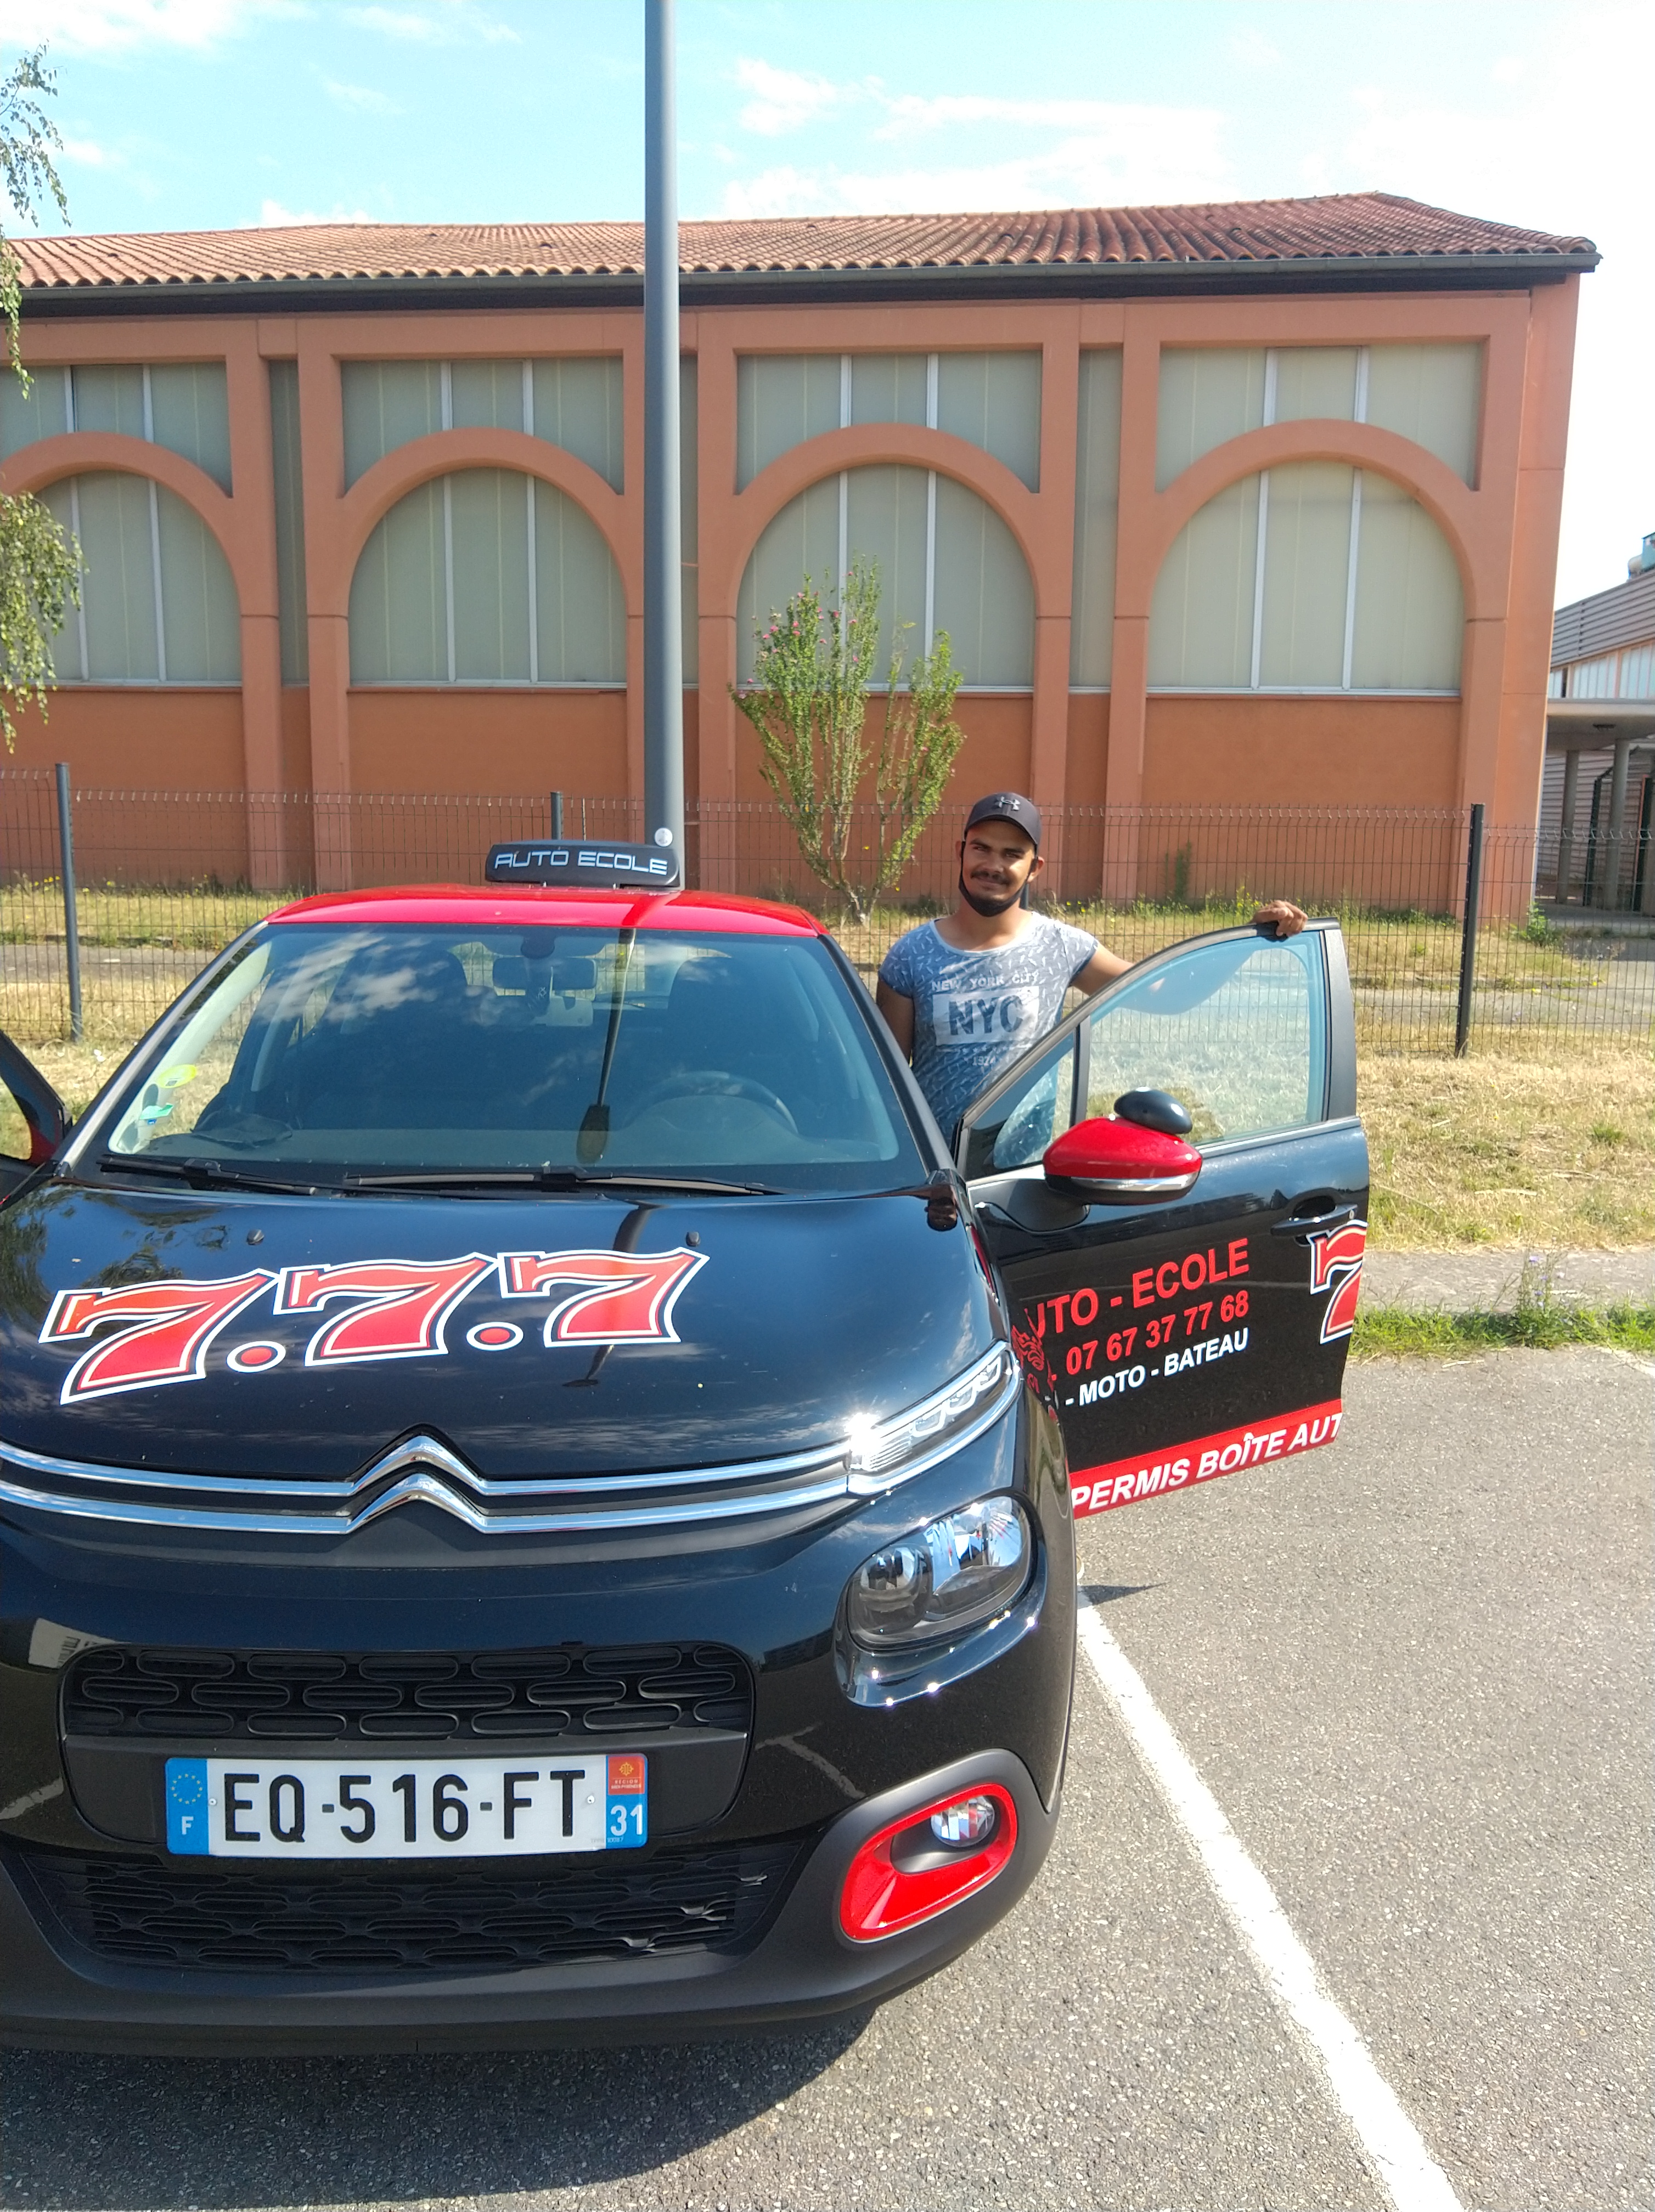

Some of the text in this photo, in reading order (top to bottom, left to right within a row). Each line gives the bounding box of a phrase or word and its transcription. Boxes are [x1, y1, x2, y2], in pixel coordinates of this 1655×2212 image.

[494, 850, 668, 876] AUTO ECOLE
[932, 969, 1039, 991] NEW YORK CITY
[948, 995, 1024, 1035] NYC
[1132, 1238, 1249, 1308] ECOLE
[1066, 1290, 1249, 1375] 07 67 37 77 68
[1079, 1364, 1146, 1406] MOTO
[1164, 1327, 1249, 1376] BATEAU
[1072, 1458, 1190, 1510] PERMIS
[1196, 1432, 1287, 1479] BOÎTE
[182, 1816, 194, 1835] F
[224, 1770, 586, 1843] EQ-516-FT
[610, 1804, 643, 1836] 31
